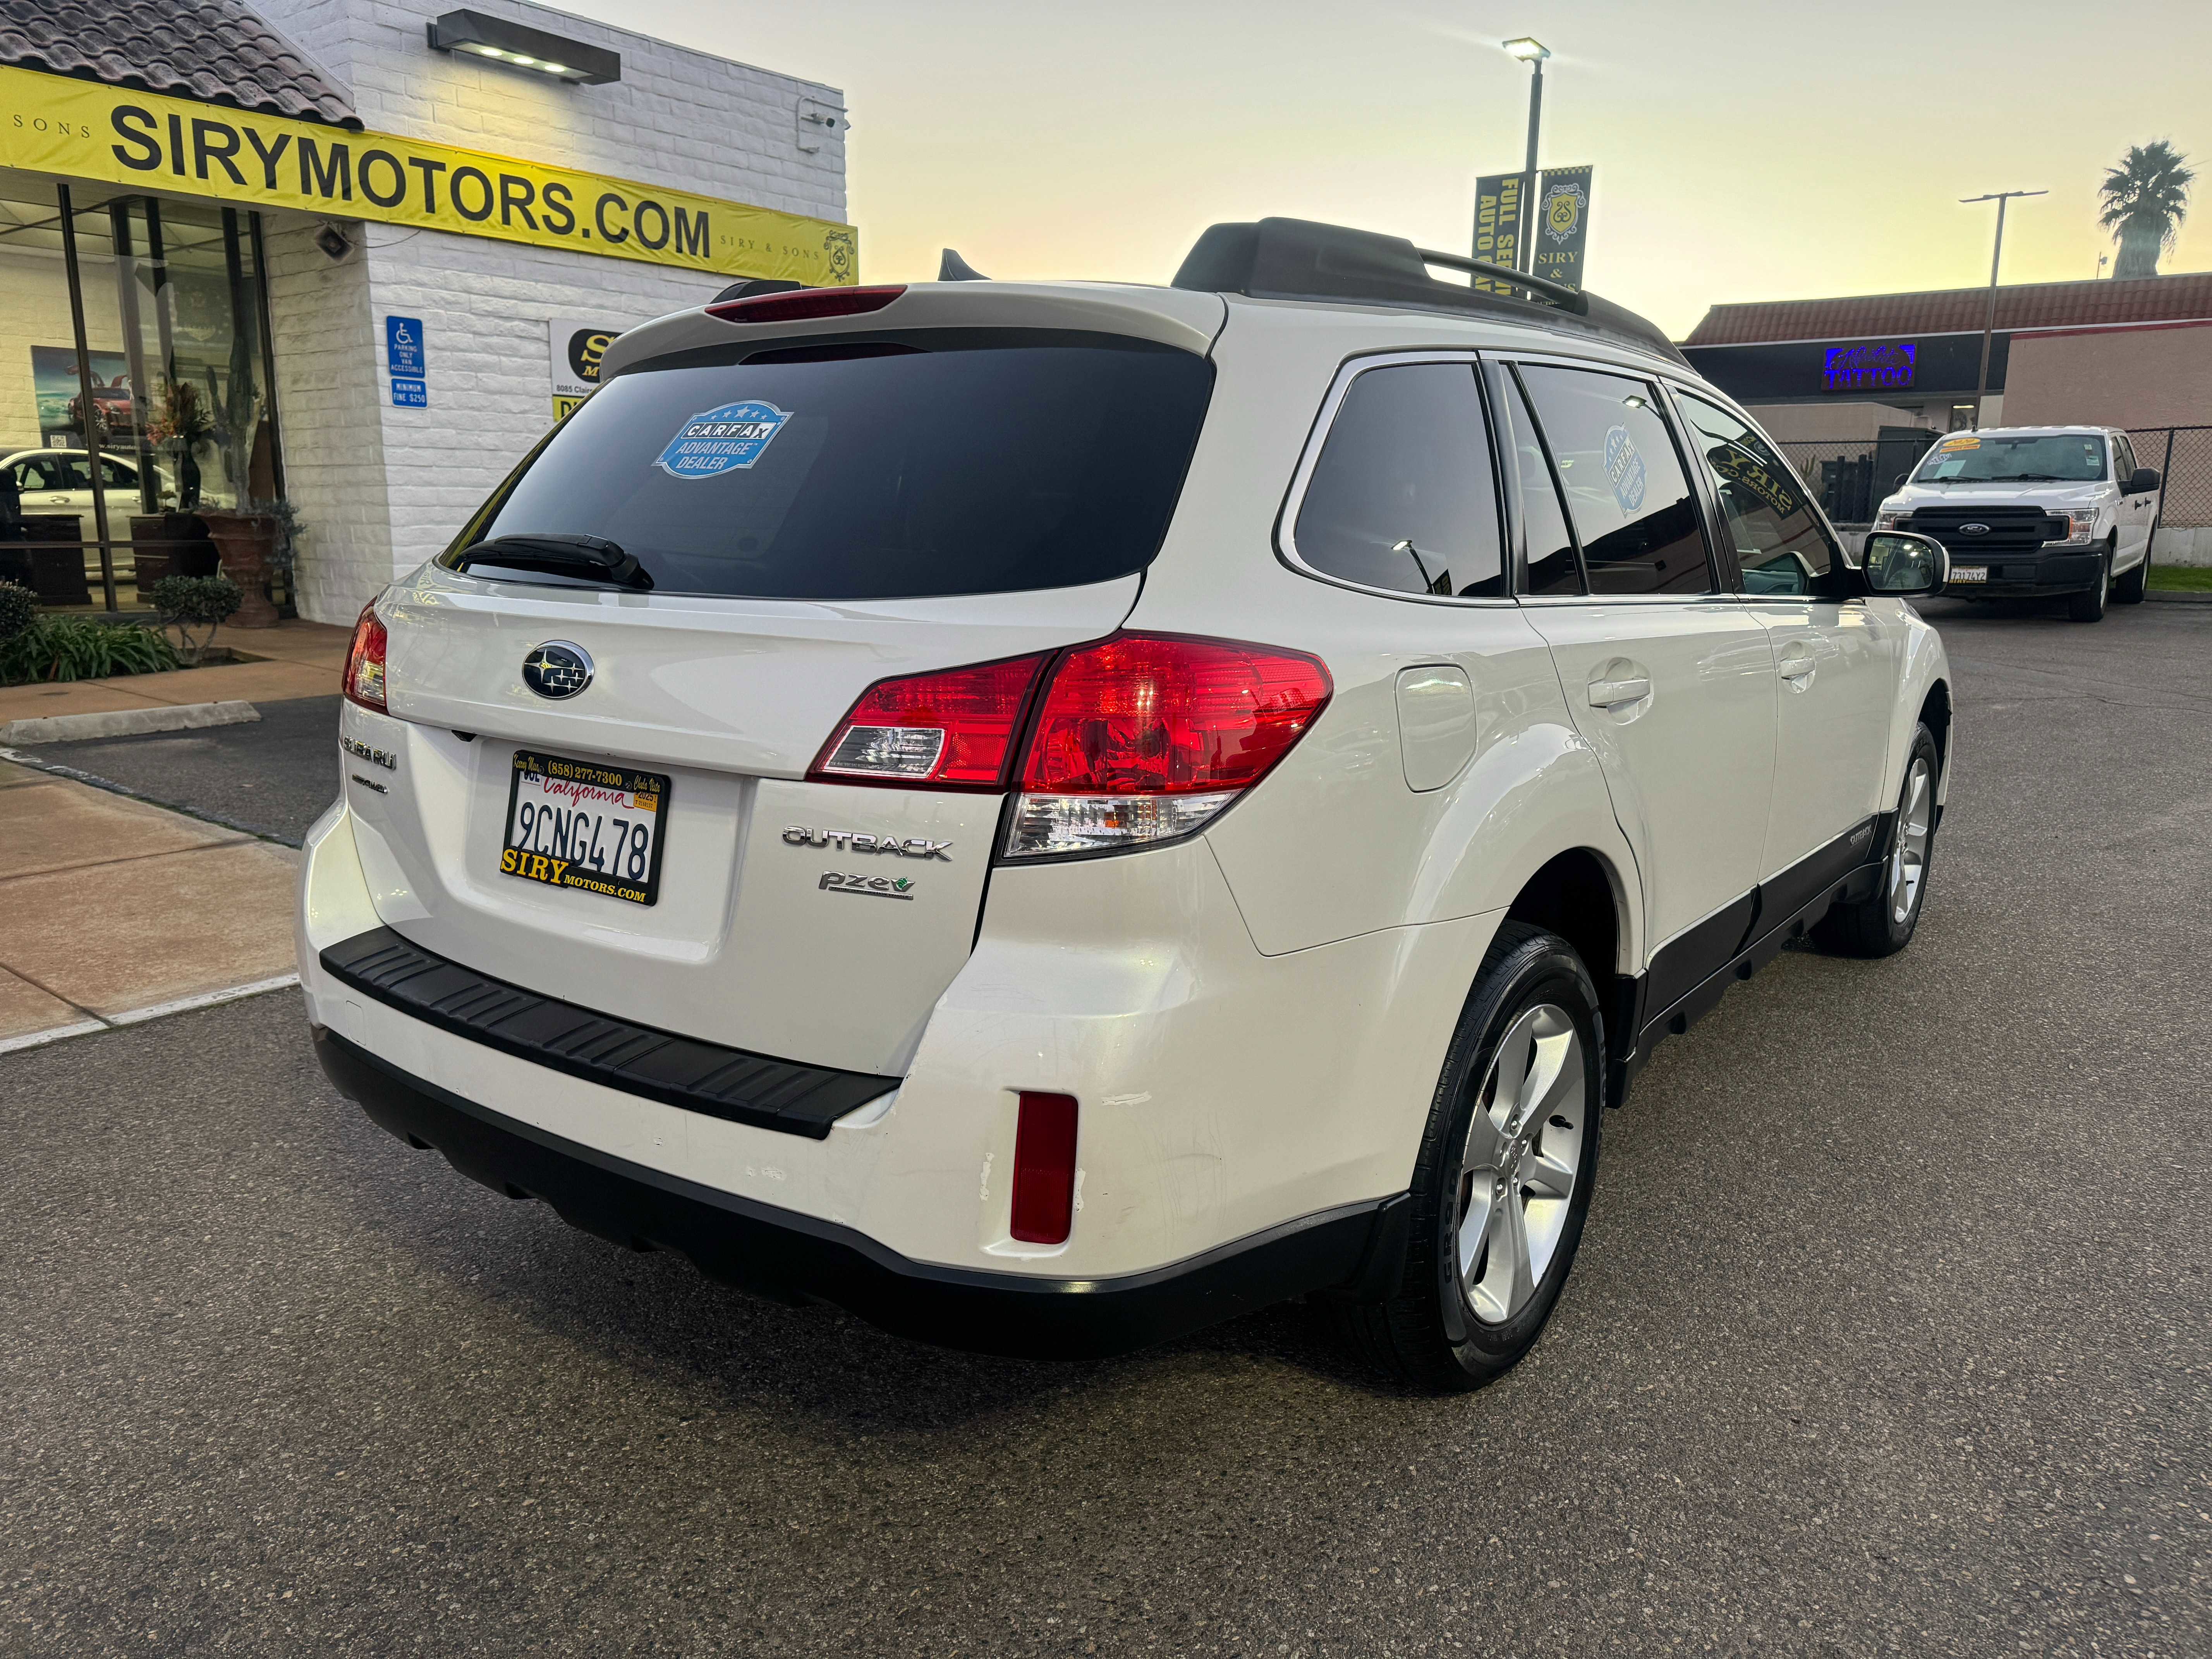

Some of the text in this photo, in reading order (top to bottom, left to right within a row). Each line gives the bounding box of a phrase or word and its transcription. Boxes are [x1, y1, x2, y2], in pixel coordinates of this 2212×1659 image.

[13, 105, 819, 260] SONS SIRYMOTORS.COM SIRY & SONS
[1498, 177, 1519, 226] FULL
[1477, 195, 1497, 251] AUTO
[1538, 252, 1578, 264] SIRY
[1550, 269, 1562, 278] &
[391, 364, 423, 373] ACCESSIBLE
[1824, 366, 1913, 389] TATTOO
[393, 392, 426, 403] FINE $250
[396, 383, 421, 392] MINIMUM
[556, 385, 573, 393] 8085
[687, 424, 771, 439] CARFAX
[675, 456, 728, 469] DEALER
[1611, 436, 1635, 483] CARFAX
[1628, 476, 1644, 507] DEALER
[1953, 572, 1985, 580] 73174Y2
[544, 776, 635, 809] California
[638, 791, 653, 801] 2025
[517, 802, 649, 880] 9CNG478
[782, 826, 953, 862] OUTBACK
[1850, 824, 1872, 845] OUTBACK
[501, 848, 646, 902] SIRY MOTORS.COM
